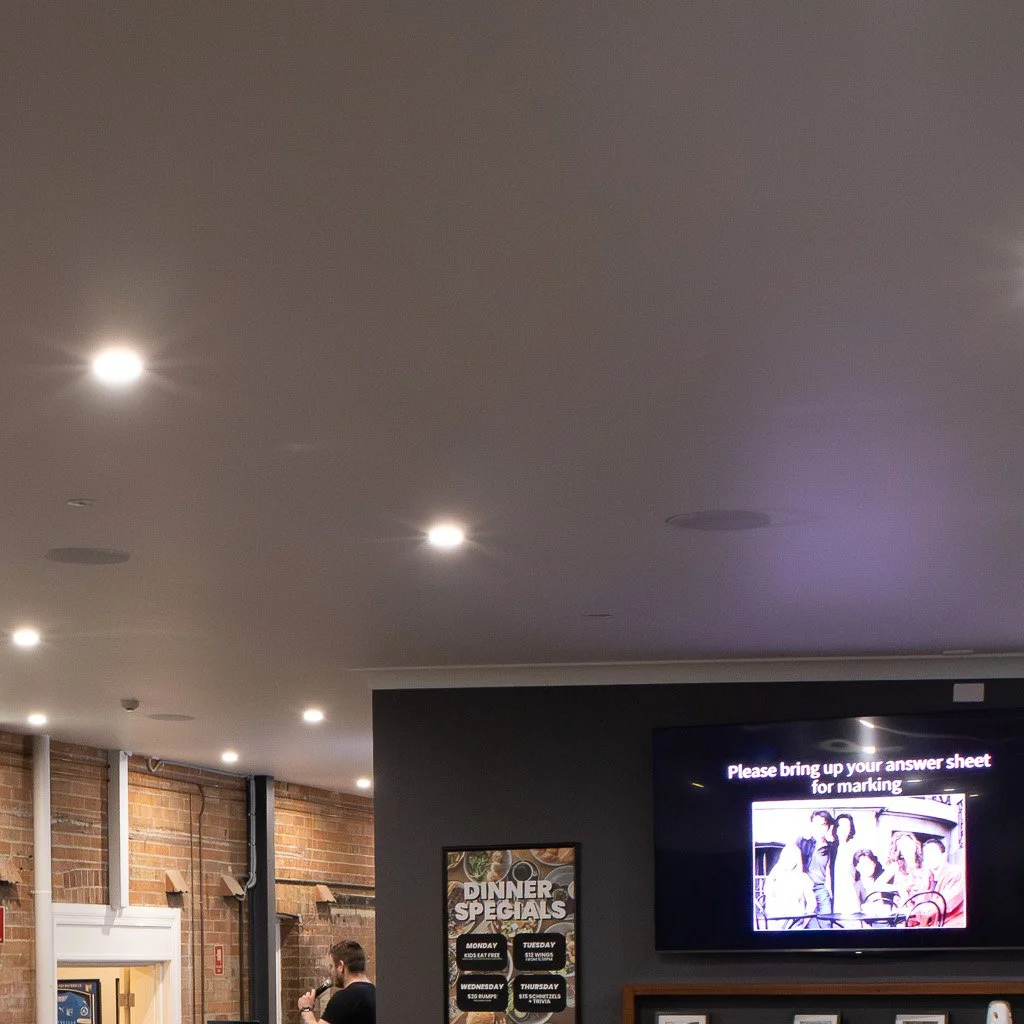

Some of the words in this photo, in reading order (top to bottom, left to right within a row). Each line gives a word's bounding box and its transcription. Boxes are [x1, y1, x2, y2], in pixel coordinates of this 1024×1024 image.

[727, 764, 777, 780] Please
[779, 761, 821, 779] bring
[823, 763, 845, 778] up
[846, 761, 884, 777] your
[885, 757, 944, 771] answer
[946, 753, 992, 769] sheet
[811, 779, 835, 795] for
[837, 778, 903, 795] marking
[463, 880, 553, 900] DINNER
[454, 900, 567, 921] SPECIALS
[523, 941, 556, 949] TUESDAY
